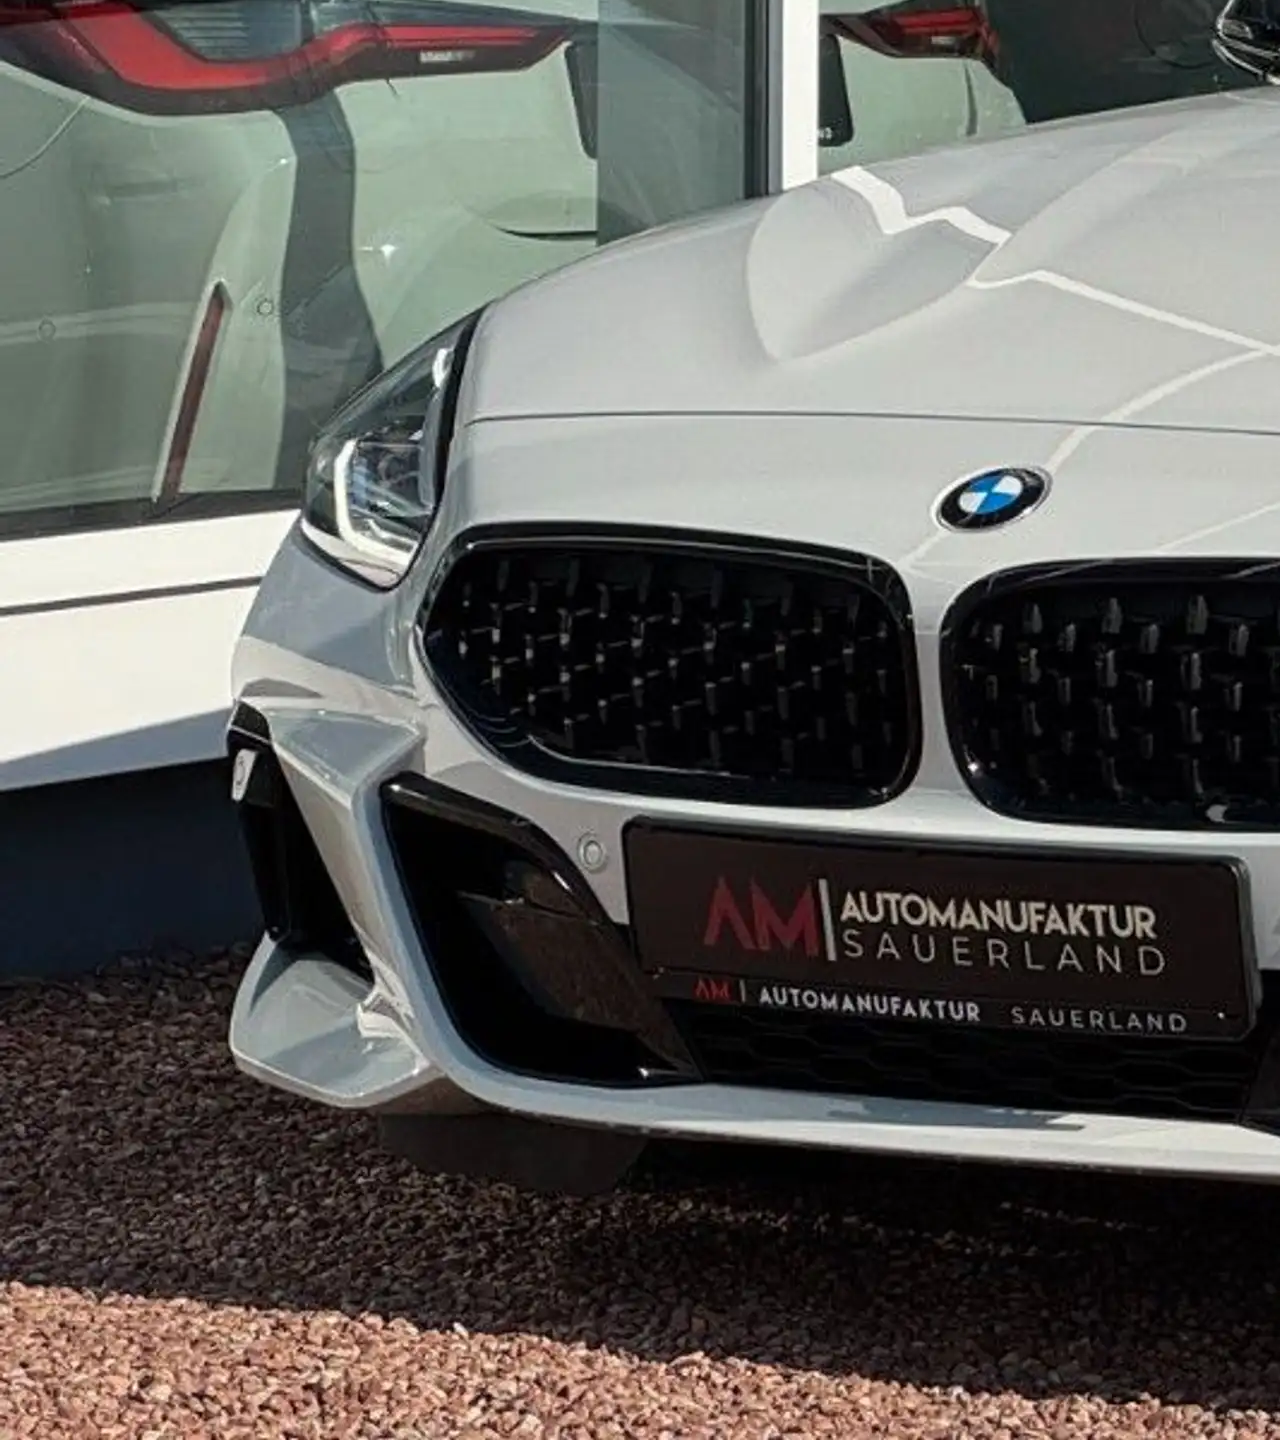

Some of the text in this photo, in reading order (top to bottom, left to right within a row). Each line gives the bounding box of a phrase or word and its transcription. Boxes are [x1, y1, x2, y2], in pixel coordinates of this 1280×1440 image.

[703, 876, 819, 957] AM
[839, 890, 1158, 940] AUTOMANUFAKTUR
[842, 928, 1166, 976] SAUERLAND
[695, 977, 1188, 1033] AM AUTOMANUFAKTUR SAUERLAND
